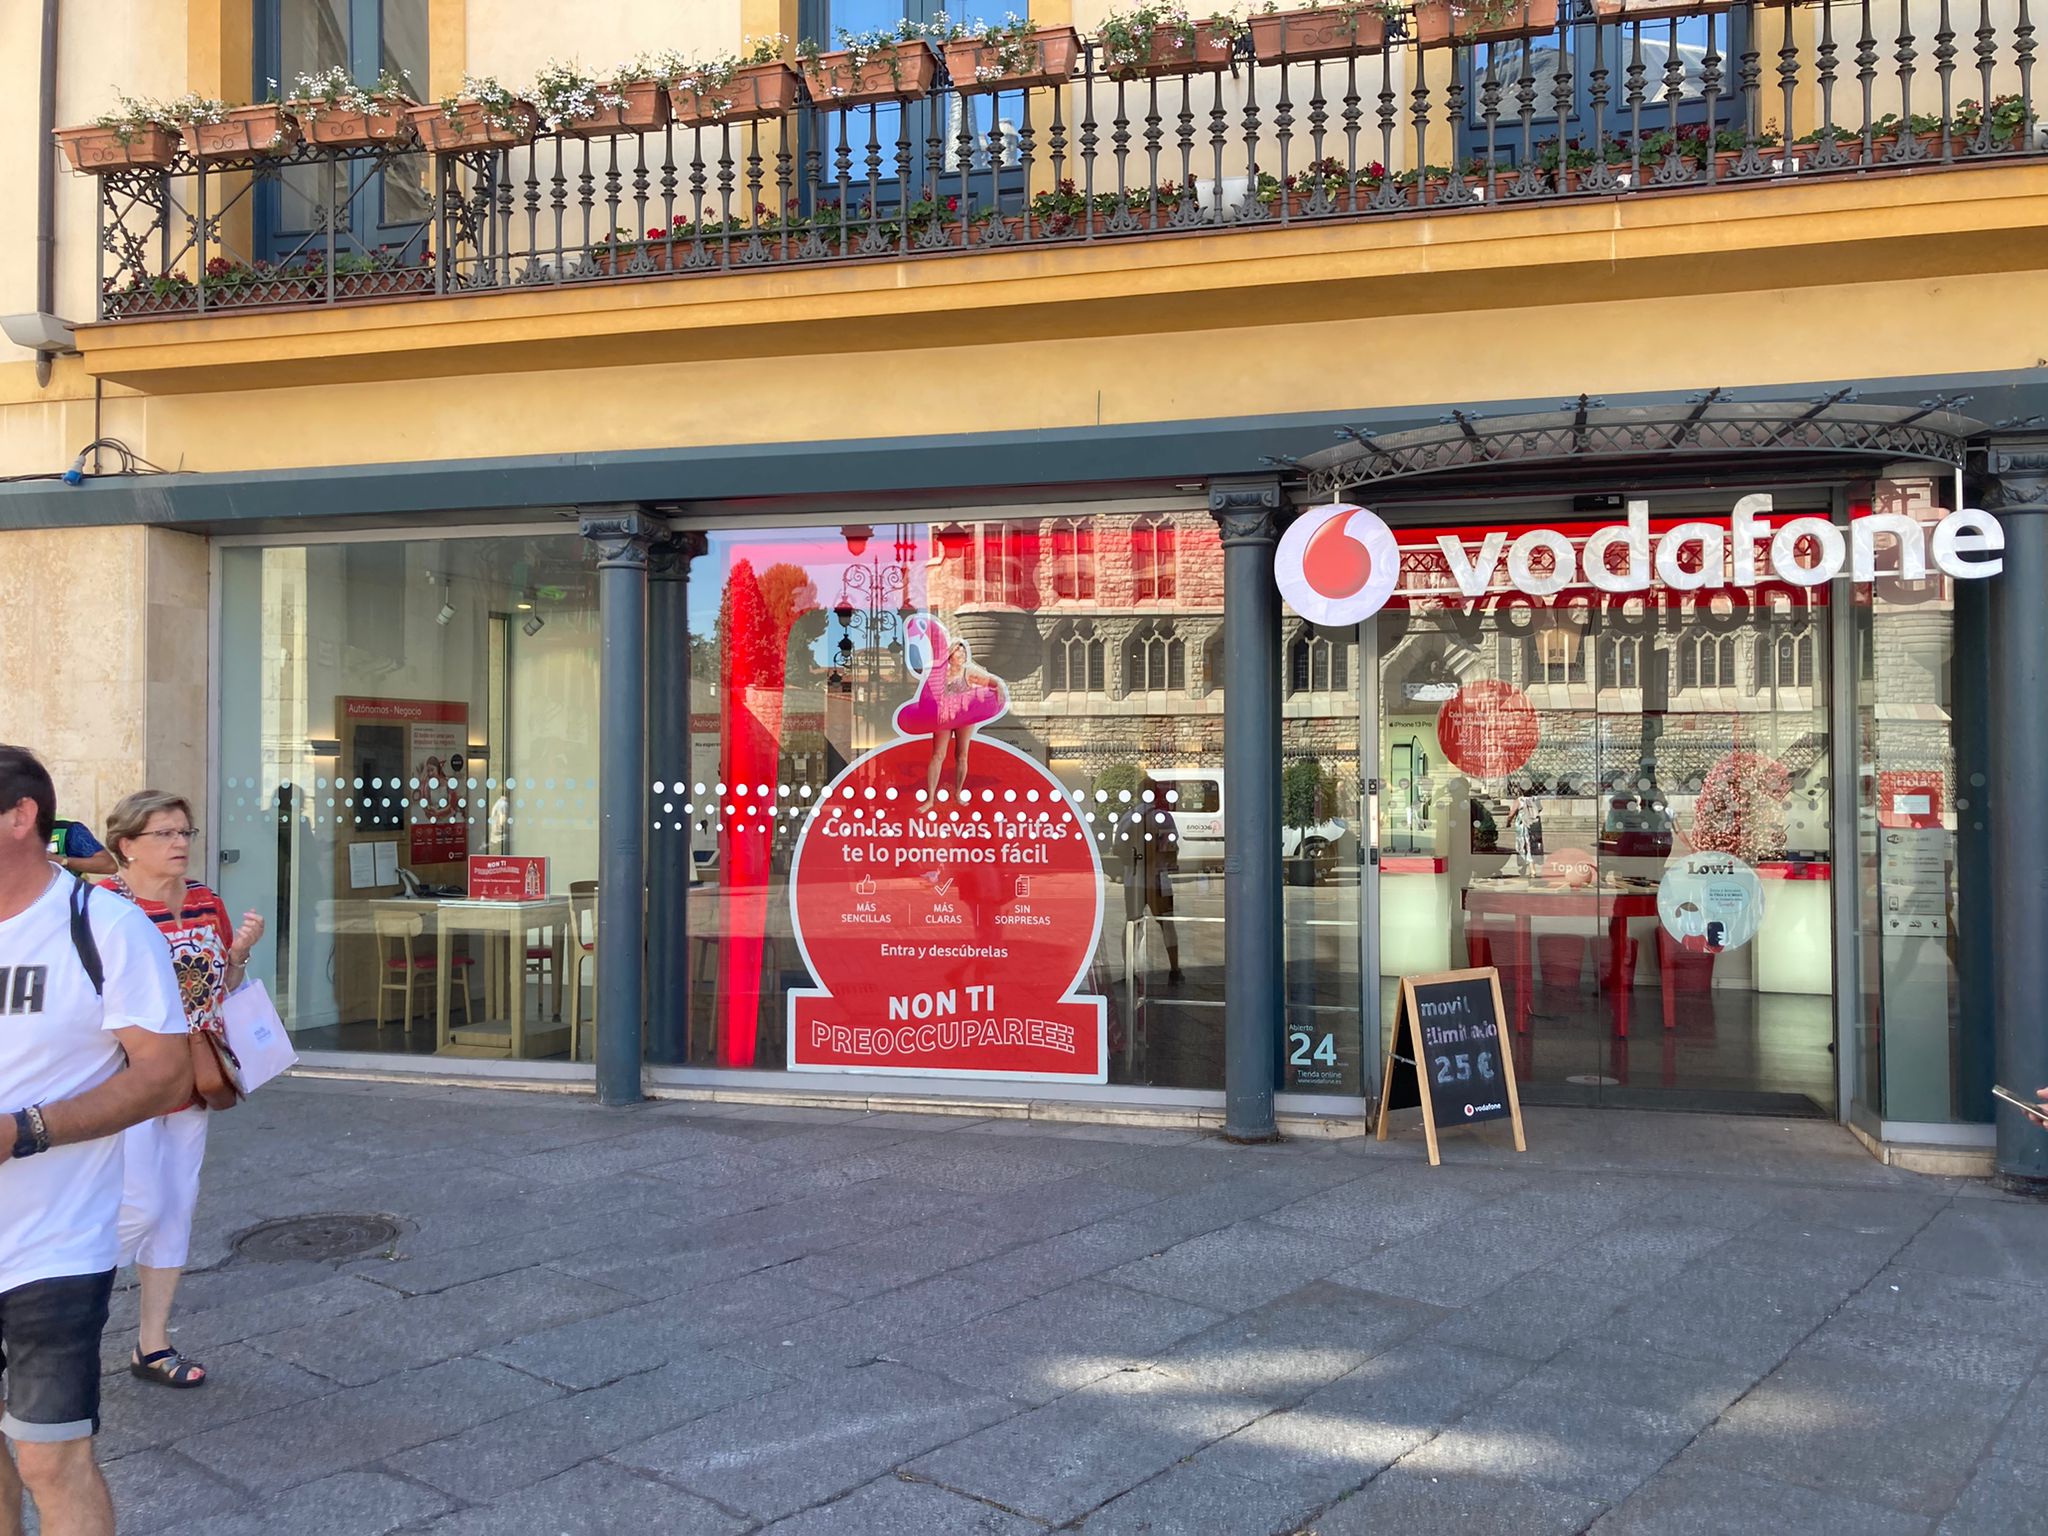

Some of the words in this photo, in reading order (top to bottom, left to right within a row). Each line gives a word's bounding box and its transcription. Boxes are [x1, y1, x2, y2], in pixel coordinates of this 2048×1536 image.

[1437, 493, 2005, 597] vodafone
[348, 704, 389, 714] Autónomos
[394, 705, 422, 717] Negocio
[824, 817, 867, 838] Con
[872, 818, 903, 838] las
[908, 818, 989, 839] Nuevas
[995, 817, 1067, 839] Tarifas
[842, 844, 863, 862] te
[869, 843, 889, 862] lo
[895, 847, 996, 867] ponemos
[1001, 843, 1049, 864] fácil
[1551, 862, 1573, 874] Top
[1687, 861, 1735, 875] Lowi
[856, 902, 876, 912] MÁS
[933, 902, 954, 913] MÁS
[1014, 904, 1031, 914] SIN
[841, 914, 892, 924] SENCILLAS
[925, 914, 962, 925] CLARAS
[994, 915, 1051, 926] SORPRESAS
[881, 944, 916, 957] Entra
[918, 947, 927, 959] y
[929, 945, 1008, 958] descúbrelas
[889, 989, 957, 1020] NON
[965, 985, 995, 1012] TI
[1289, 1024, 1313, 1032] Abierto
[1289, 1032, 1337, 1066] 24
[1298, 1070, 1319, 1078] Tienda
[1320, 1071, 1342, 1079] online
[1475, 1103, 1501, 1112] vodafone
